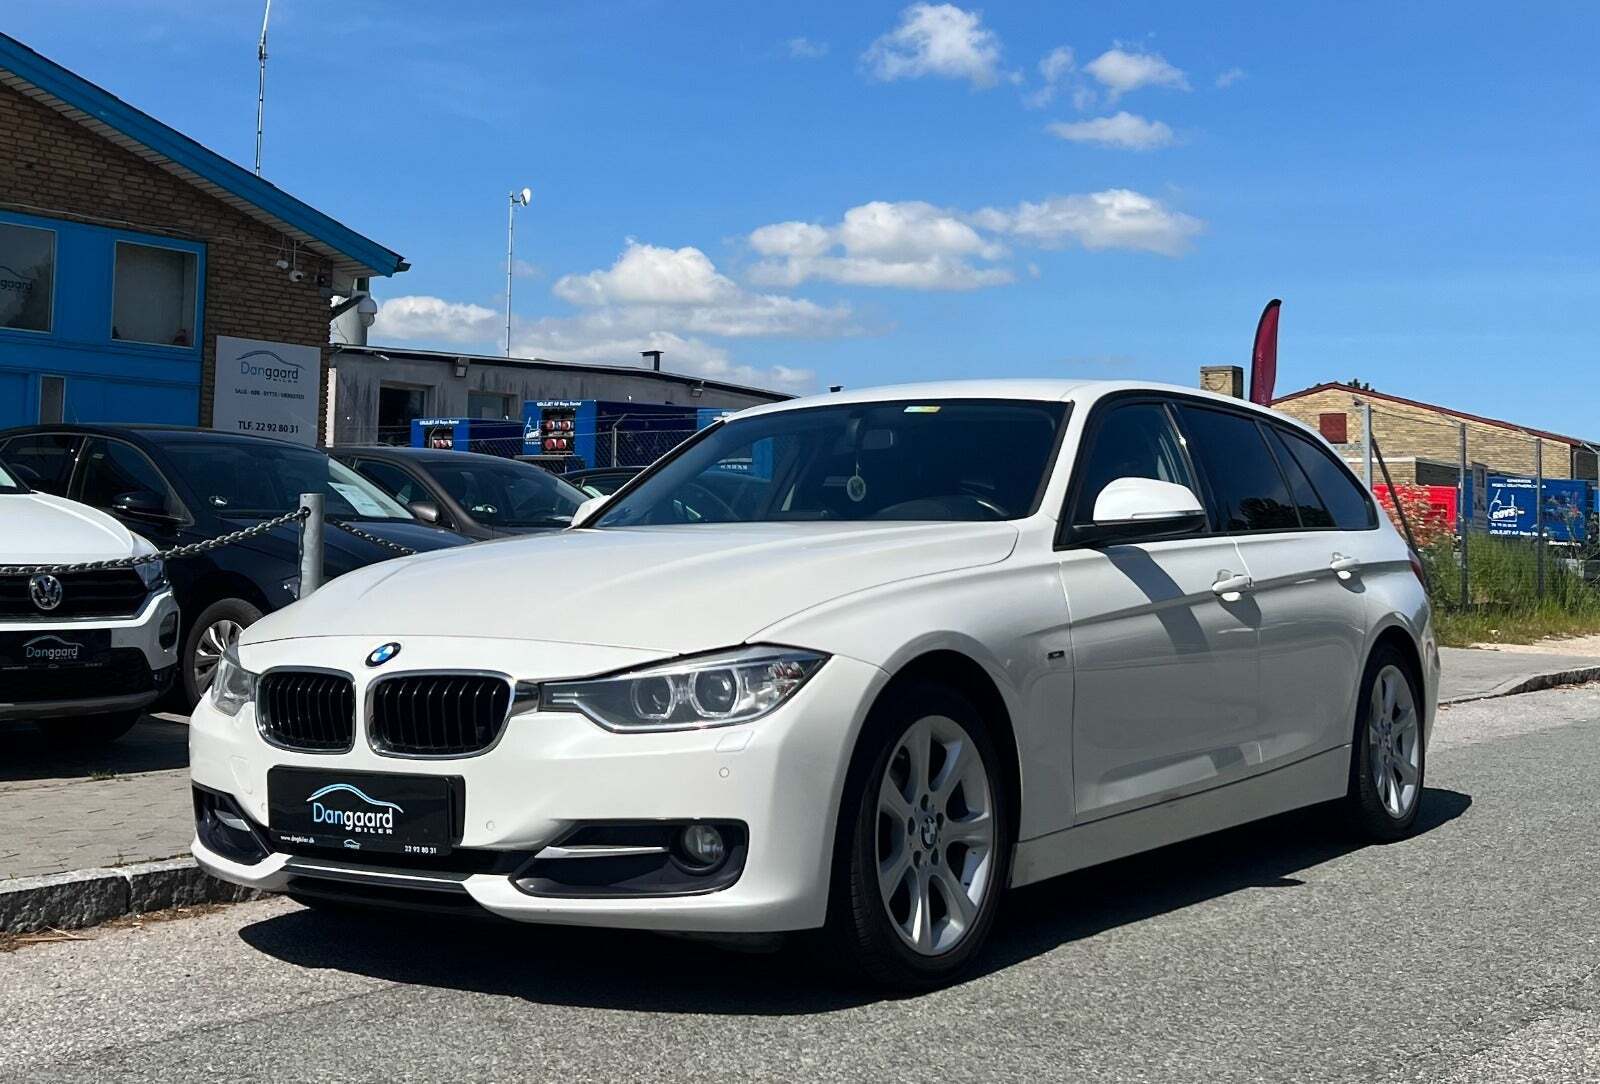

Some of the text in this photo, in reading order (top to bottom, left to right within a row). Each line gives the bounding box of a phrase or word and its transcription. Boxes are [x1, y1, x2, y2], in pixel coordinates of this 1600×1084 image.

[241, 361, 299, 380] Dangaard
[238, 420, 299, 433] TLF. 22 92 80 31
[26, 645, 78, 660] Dangaard
[313, 802, 393, 831] Dangaard
[355, 827, 393, 835] BILER
[404, 844, 411, 852] 22
[430, 846, 437, 854] 31
